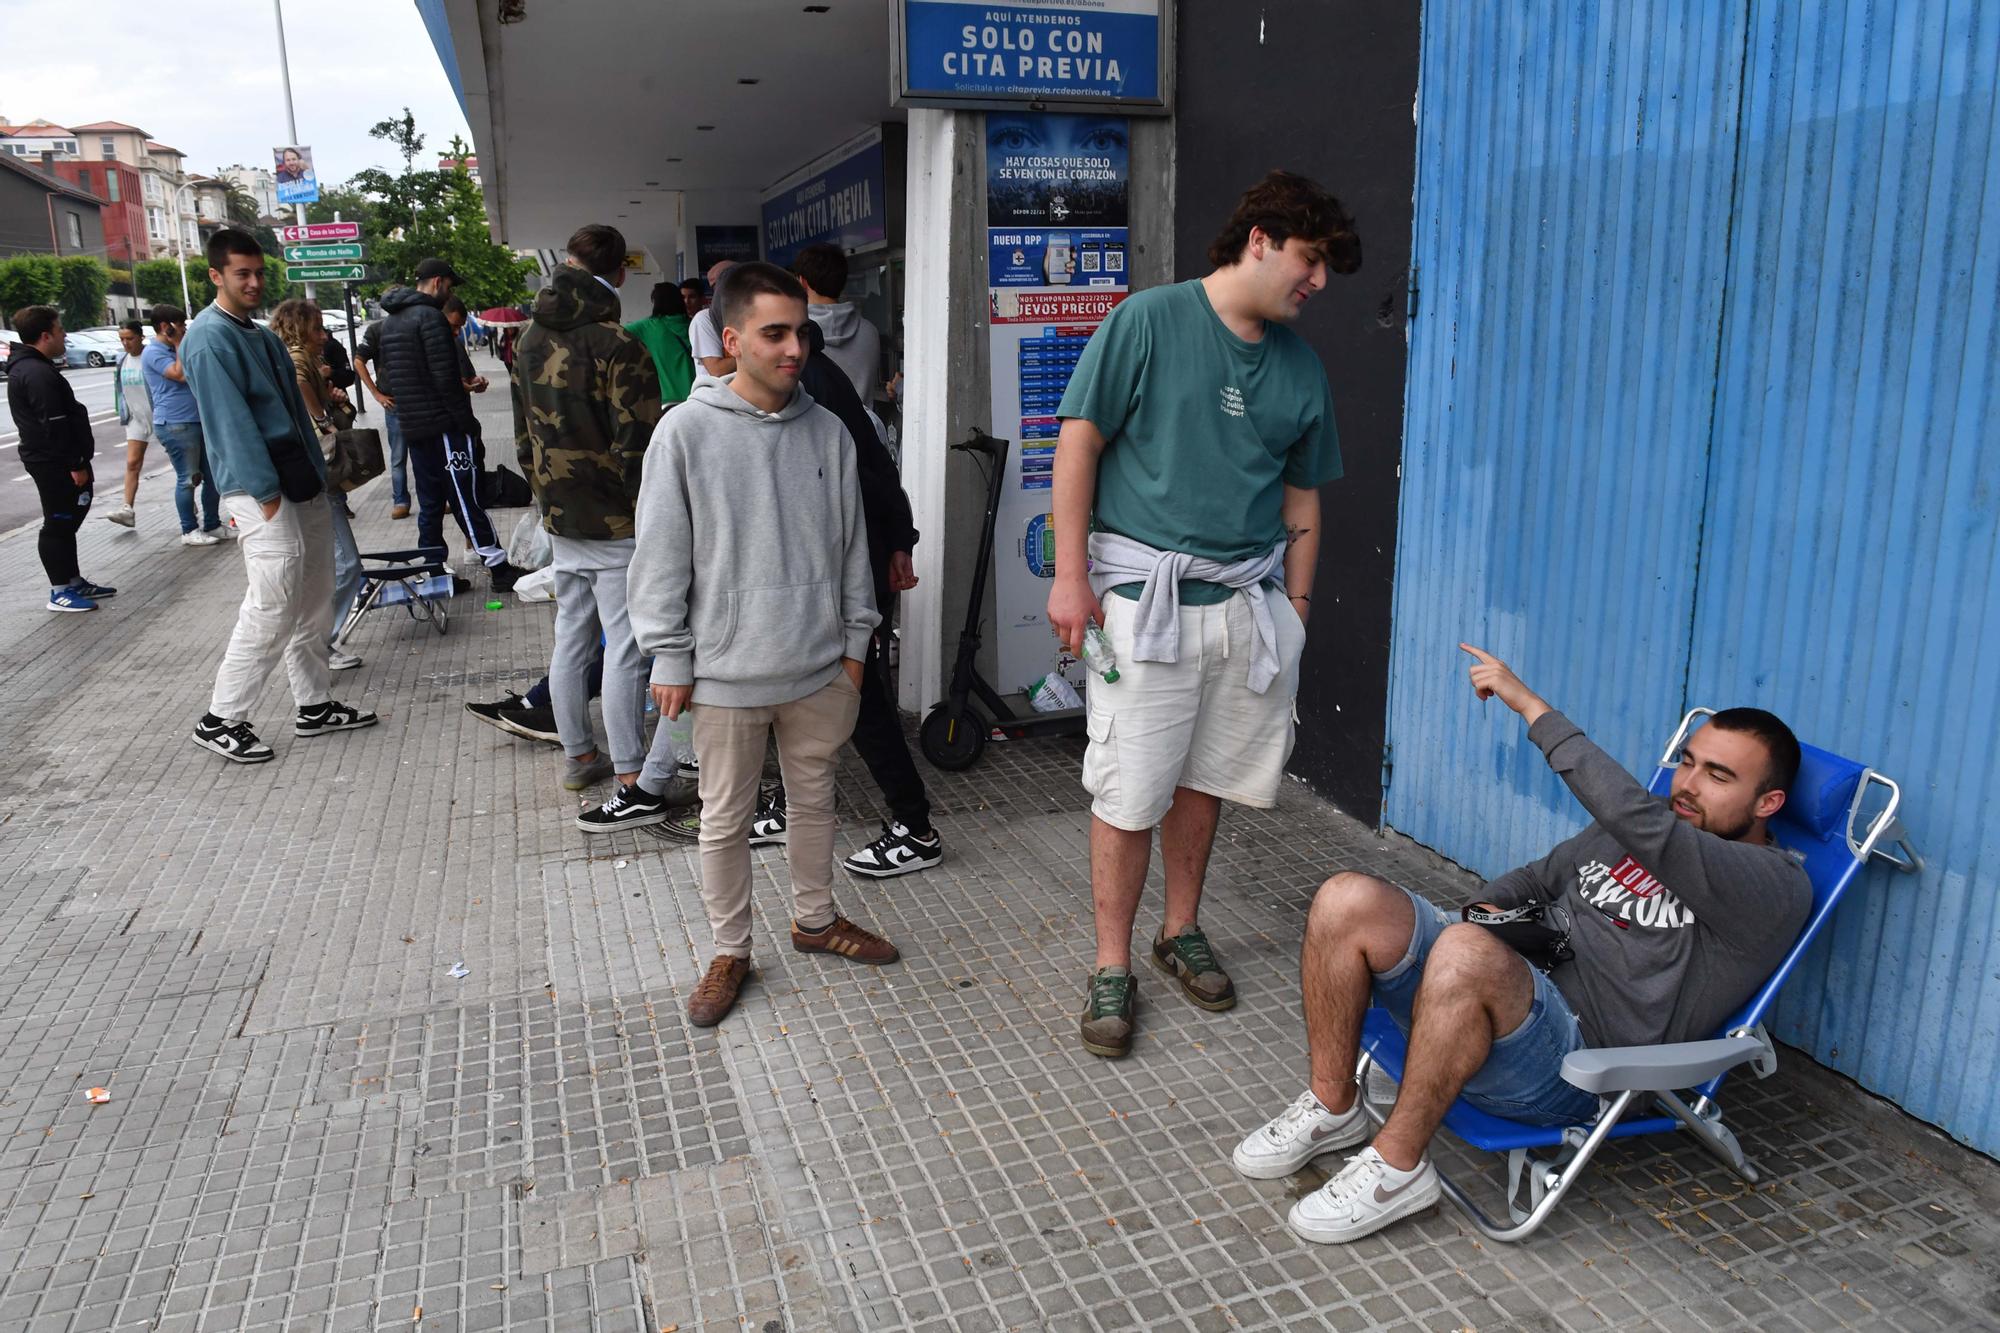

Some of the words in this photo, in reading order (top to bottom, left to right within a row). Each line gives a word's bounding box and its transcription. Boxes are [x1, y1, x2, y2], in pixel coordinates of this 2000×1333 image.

[985, 11, 1011, 22] AQUÍ
[1015, 13, 1081, 25] ATENDEMOS
[962, 25, 1034, 50] SOLO
[1048, 31, 1102, 54] CON
[943, 52, 1006, 77] CITA
[1019, 57, 1121, 82] PREVIA
[1007, 85, 1111, 97] citaprevia.rcdeportivo.es
[1005, 156, 1026, 167] HAY
[1028, 156, 1060, 168] COSAS
[1063, 157, 1084, 169] QUE
[1085, 157, 1110, 168] SOLO
[1000, 168, 1012, 179] SE
[1013, 168, 1033, 179] VEN
[1035, 169, 1055, 179] CON
[1057, 169, 1068, 179] EL
[1070, 167, 1117, 180] CORAZÓN
[768, 215, 787, 250] SOLO
[789, 206, 806, 244] CON
[807, 199, 828, 238] CITA
[830, 178, 871, 230] PREVIA
[993, 235, 1022, 245] NUEVA
[1024, 235, 1042, 245] APP
[1034, 295, 1075, 303] TEMPORADA
[1077, 294, 1113, 302] 2022/2023
[1019, 303, 1058, 315] UEVOS
[1062, 302, 1113, 315] PRECIOS
[1227, 401, 1245, 410] public
